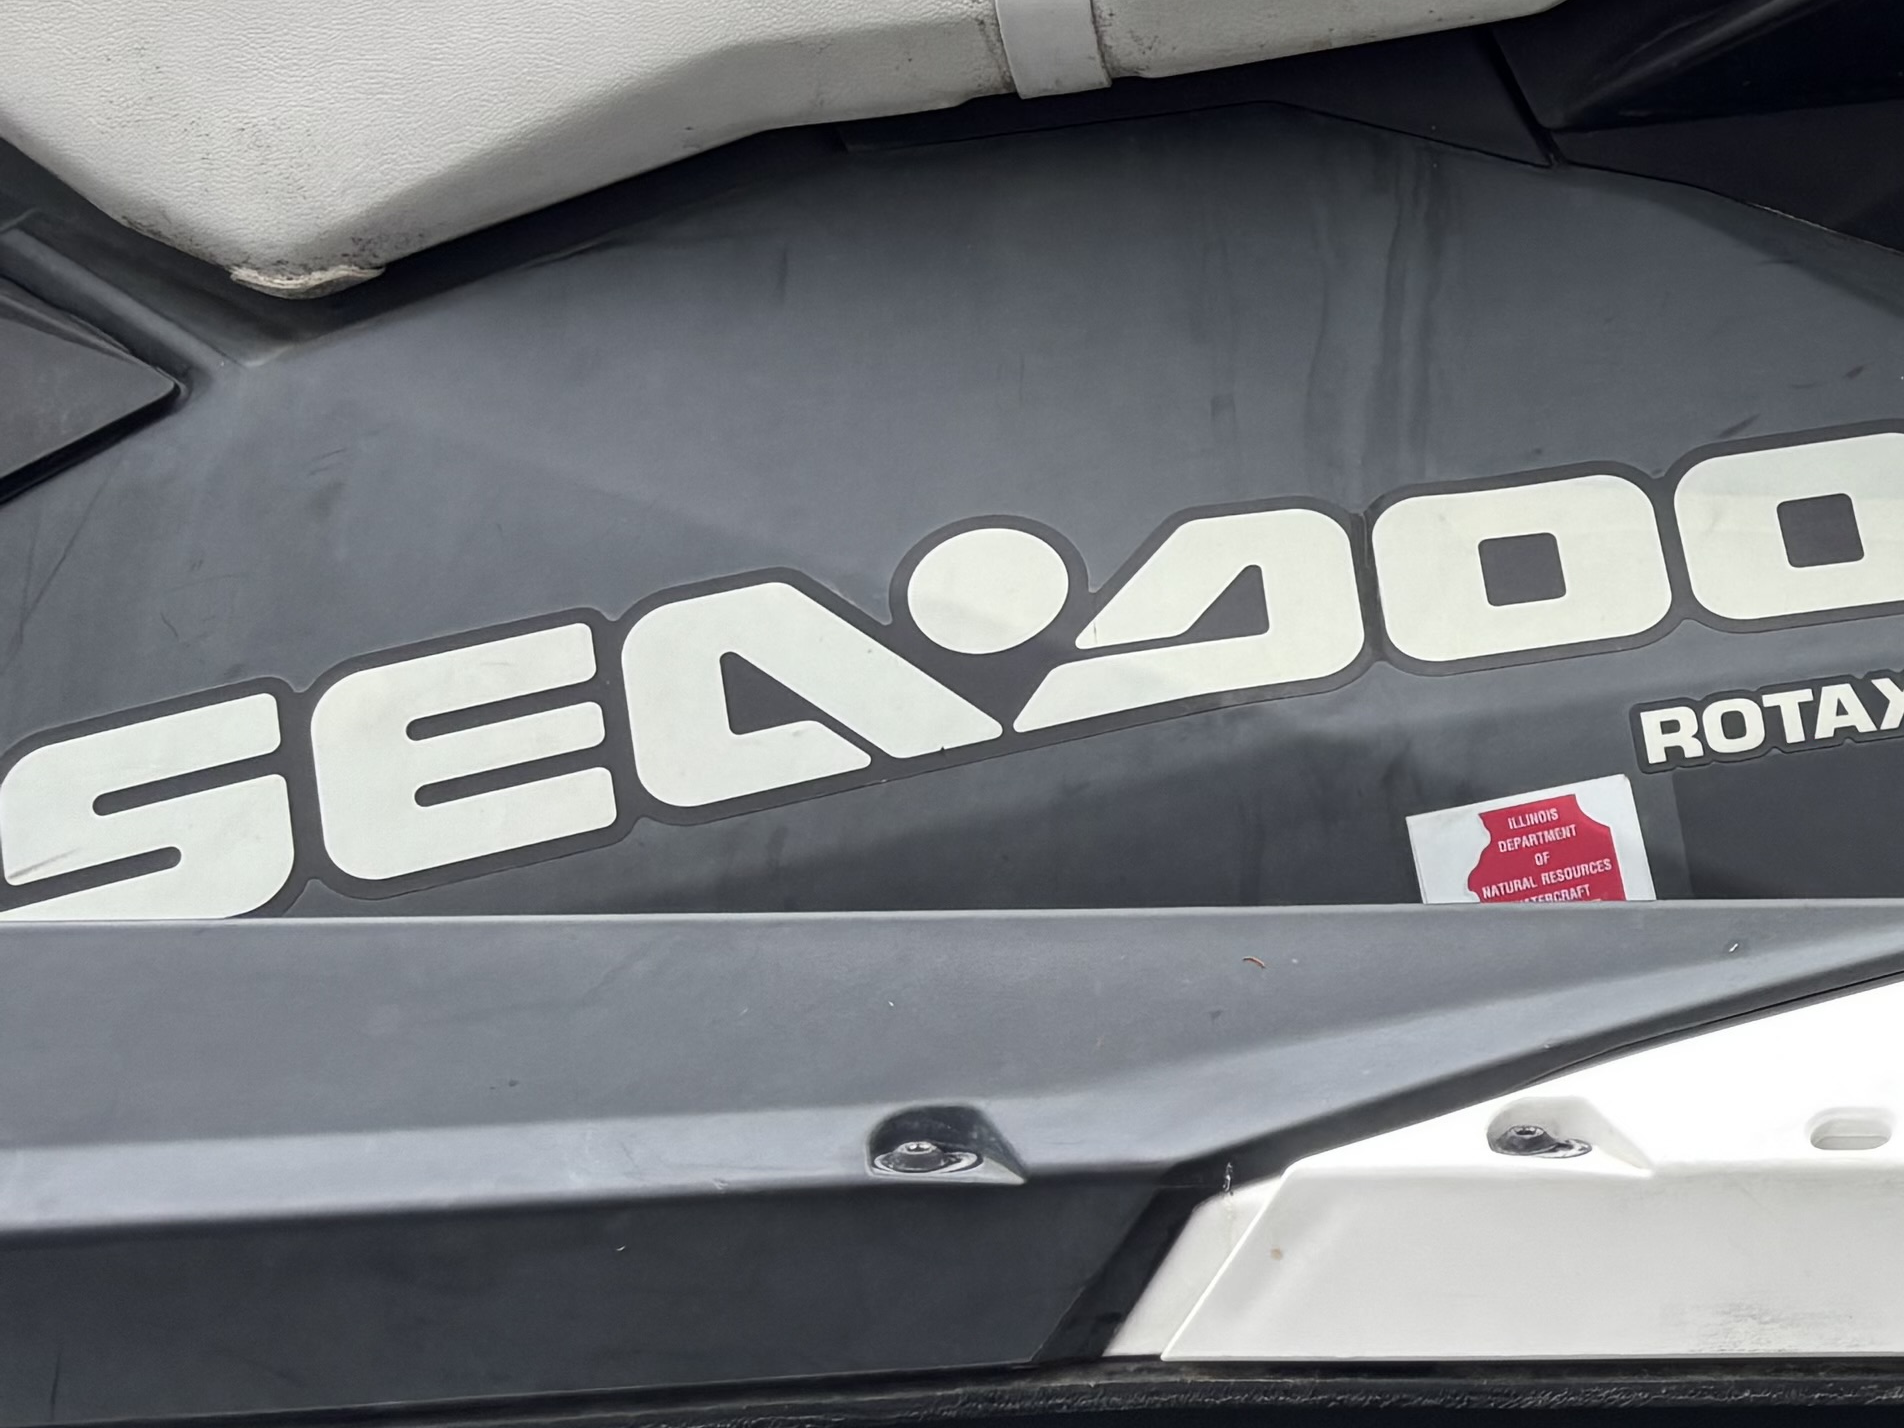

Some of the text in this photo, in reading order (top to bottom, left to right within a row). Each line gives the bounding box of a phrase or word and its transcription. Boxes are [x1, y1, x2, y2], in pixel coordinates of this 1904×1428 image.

[1508, 808, 1559, 830] ILLINOIS
[1498, 824, 1577, 853] DEPARTMENT
[1534, 851, 1551, 867] OF
[1482, 858, 1612, 899] NATURAL RESOURCES
[1519, 884, 1590, 902] TERCRAFT
